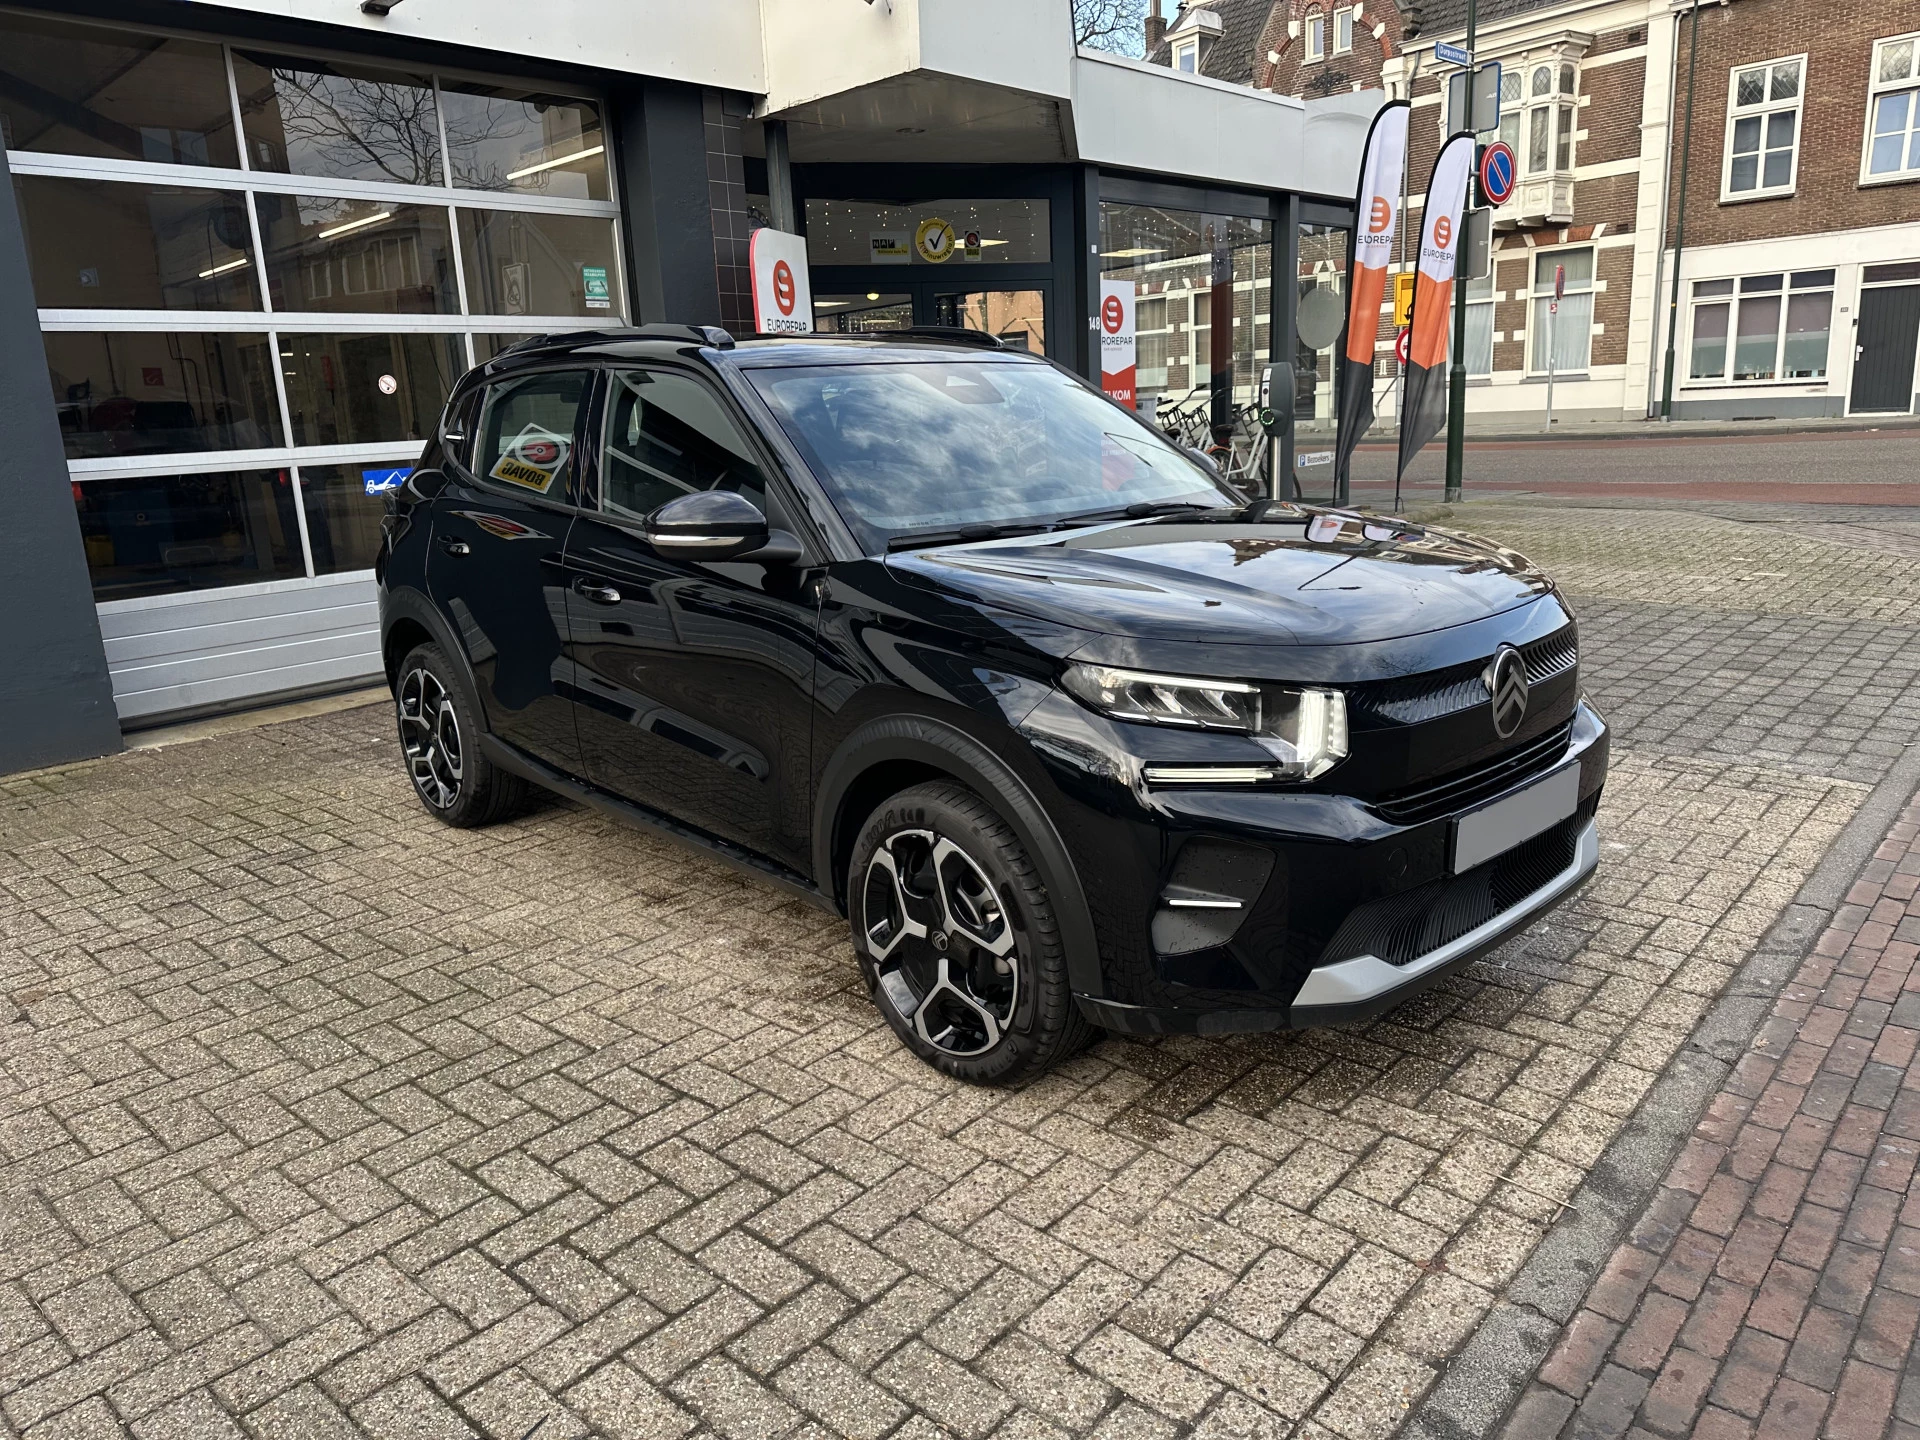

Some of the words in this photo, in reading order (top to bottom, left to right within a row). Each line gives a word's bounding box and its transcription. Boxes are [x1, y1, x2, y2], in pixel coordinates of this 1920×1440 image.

[1439, 45, 1467, 61] Dorpsstraat
[1089, 316, 1100, 331] 148
[1307, 454, 1330, 464] Bezoekers
